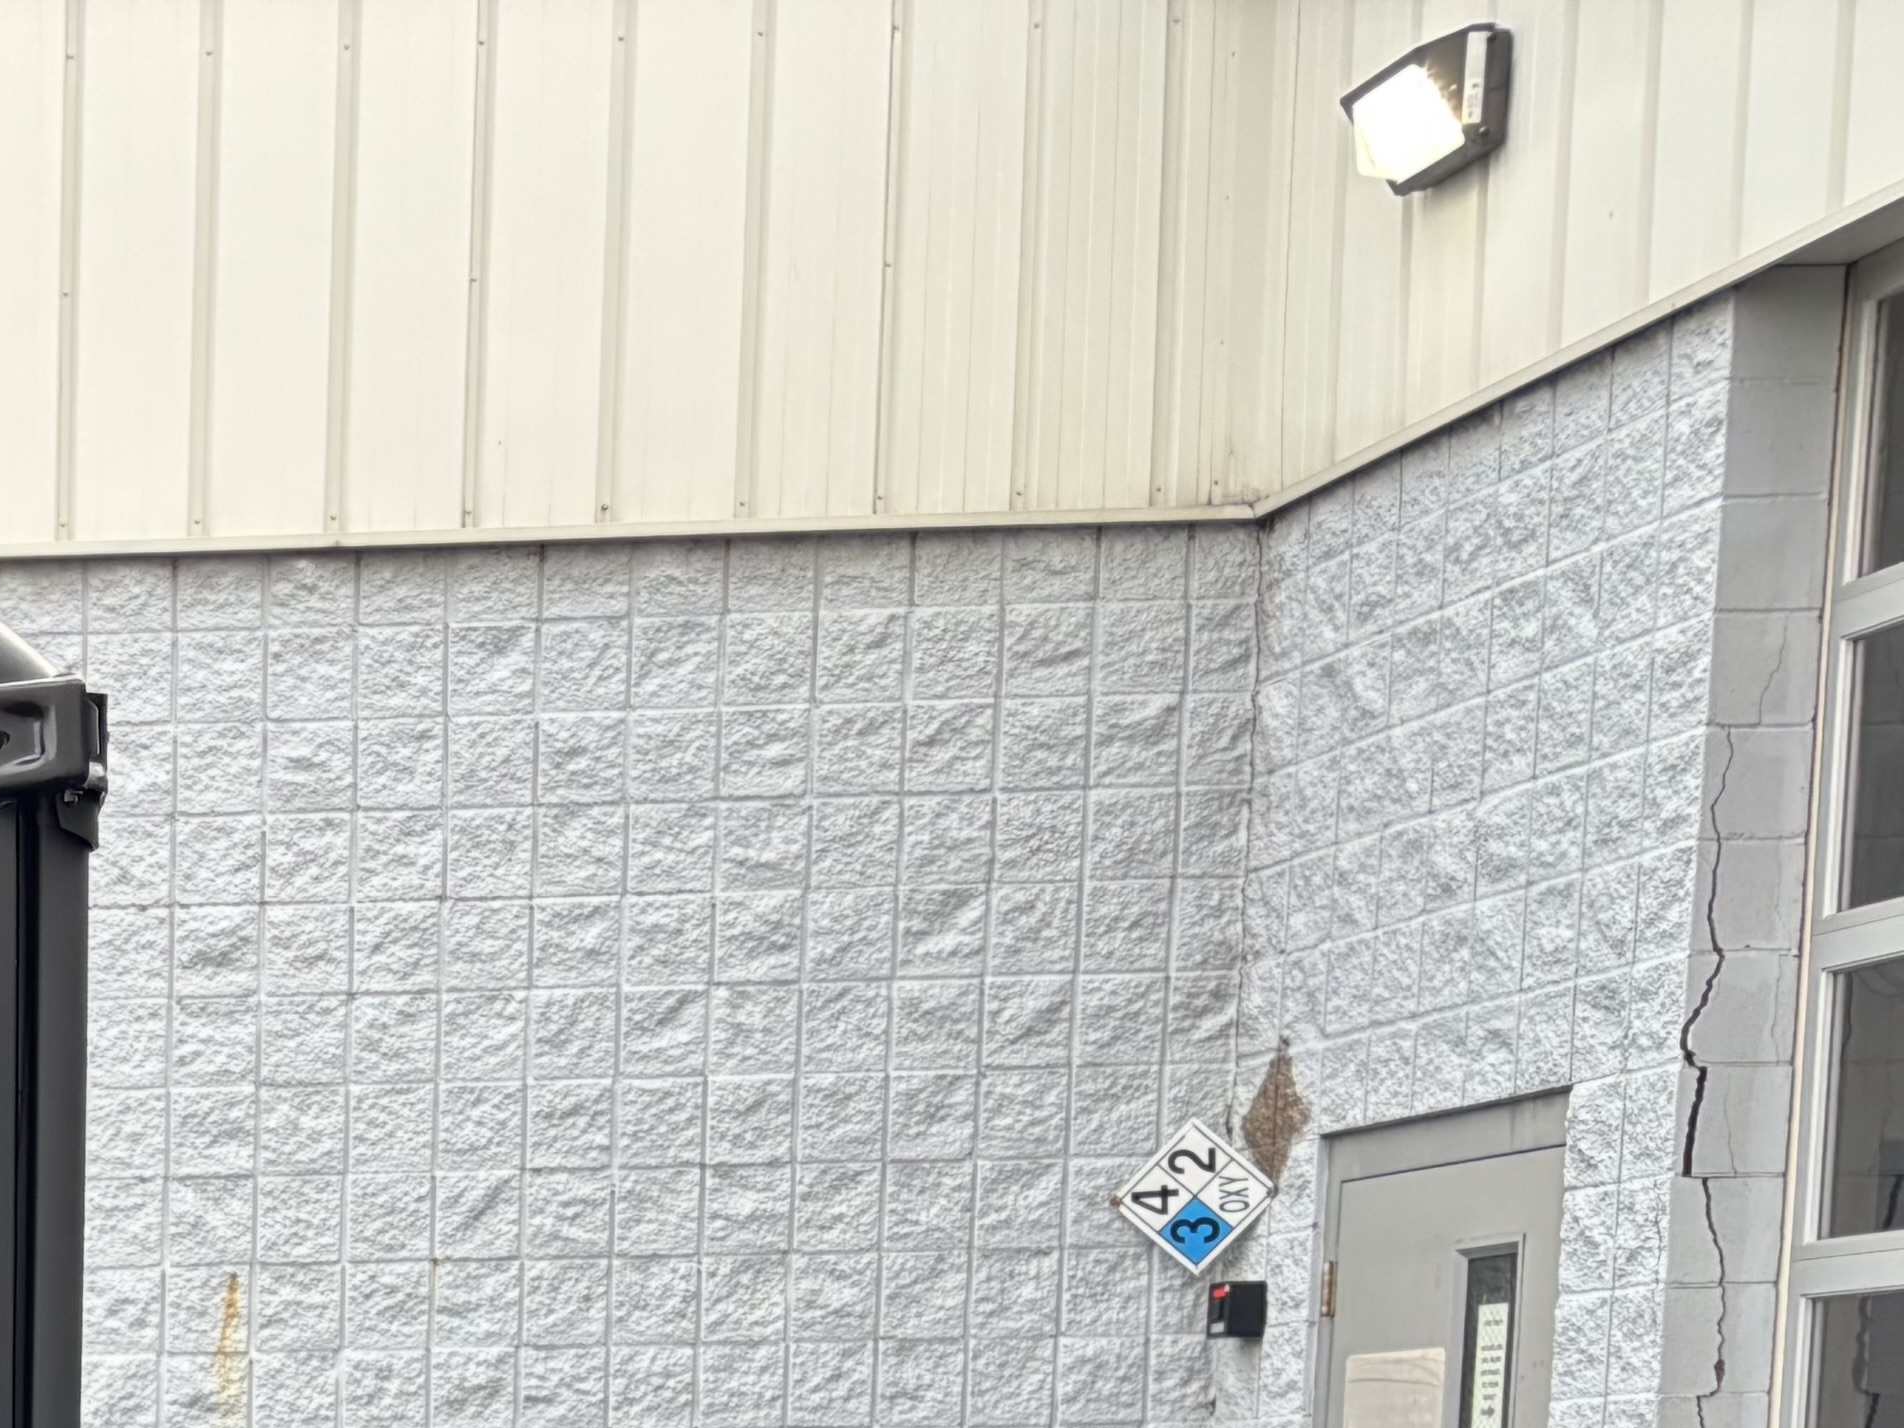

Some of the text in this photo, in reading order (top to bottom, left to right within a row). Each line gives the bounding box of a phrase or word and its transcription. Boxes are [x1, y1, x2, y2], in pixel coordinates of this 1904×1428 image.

[1167, 1147, 1216, 1175] 2
[1131, 1184, 1179, 1215] 4
[1218, 1175, 1250, 1213] OXY
[1170, 1216, 1220, 1244] 3
